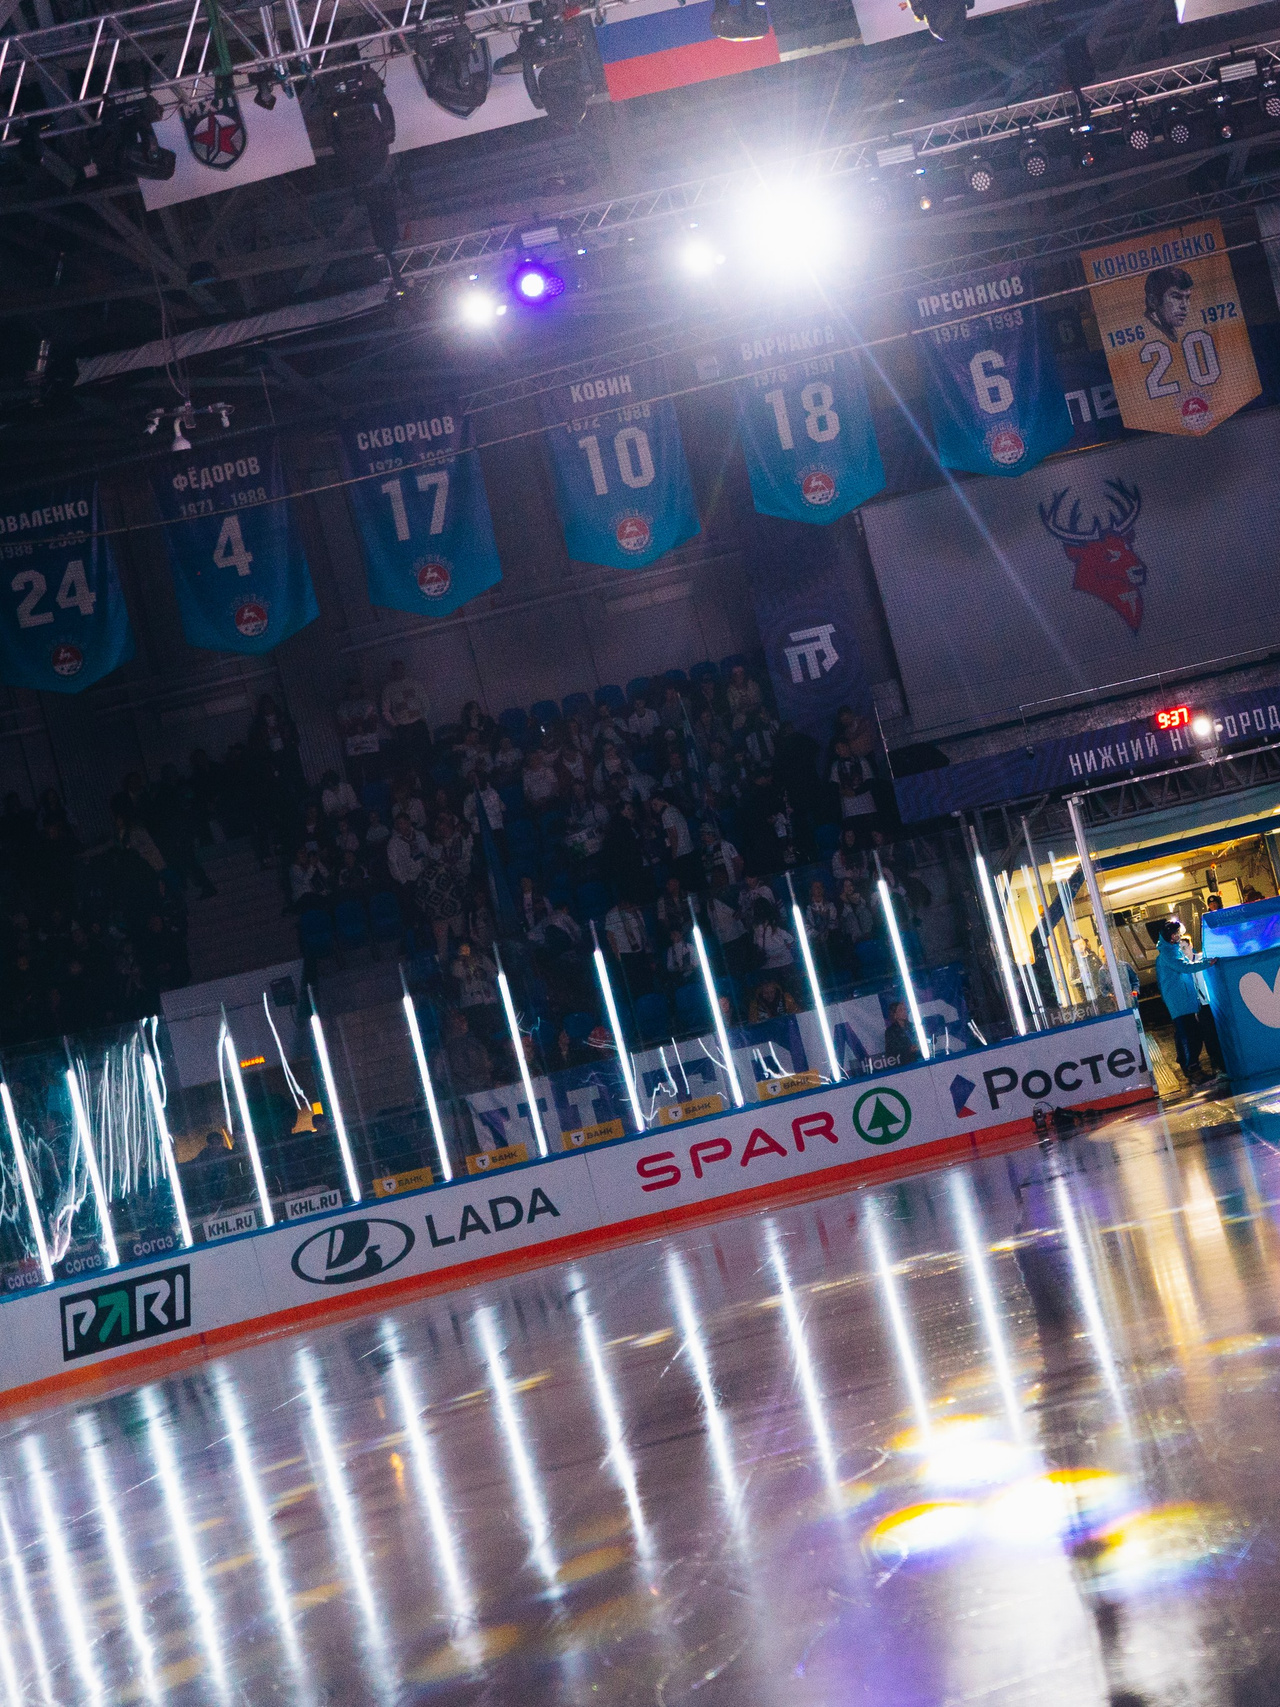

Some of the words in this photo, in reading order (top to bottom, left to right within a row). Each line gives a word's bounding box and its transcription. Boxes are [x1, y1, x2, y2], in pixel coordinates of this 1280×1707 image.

[1092, 232, 1216, 280] КОНОВАЛЕНКО
[917, 275, 1024, 318] ПРЕСНЯКОВ
[1107, 325, 1146, 348] 1956
[1200, 302, 1237, 324] 1972
[970, 350, 1014, 415] 6
[1140, 329, 1222, 400] 20
[569, 374, 633, 404] КОВИН
[356, 415, 455, 451] СКВОРЦОВ
[765, 382, 840, 451] 18
[172, 456, 261, 491] ФЁДОРОВ
[578, 426, 656, 496] 10
[381, 470, 449, 541] 17
[213, 514, 254, 576] 4
[11, 559, 97, 629] 24
[1157, 708, 1190, 730] 9:37
[1068, 732, 1159, 777] НИЖНИЙ
[1050, 1005, 1093, 1027] Haier
[862, 1053, 901, 1073] Haier
[684, 1101, 711, 1115] БАНК
[586, 1126, 613, 1139] БАНК
[636, 1111, 839, 1192] SPAR
[491, 1150, 518, 1163] БАНК
[397, 1174, 423, 1187] БАНК
[208, 1215, 253, 1238] KHL.RU
[290, 1193, 338, 1216] KHL.RU
[424, 1187, 560, 1249] LADA
[64, 1274, 187, 1352] PARI
